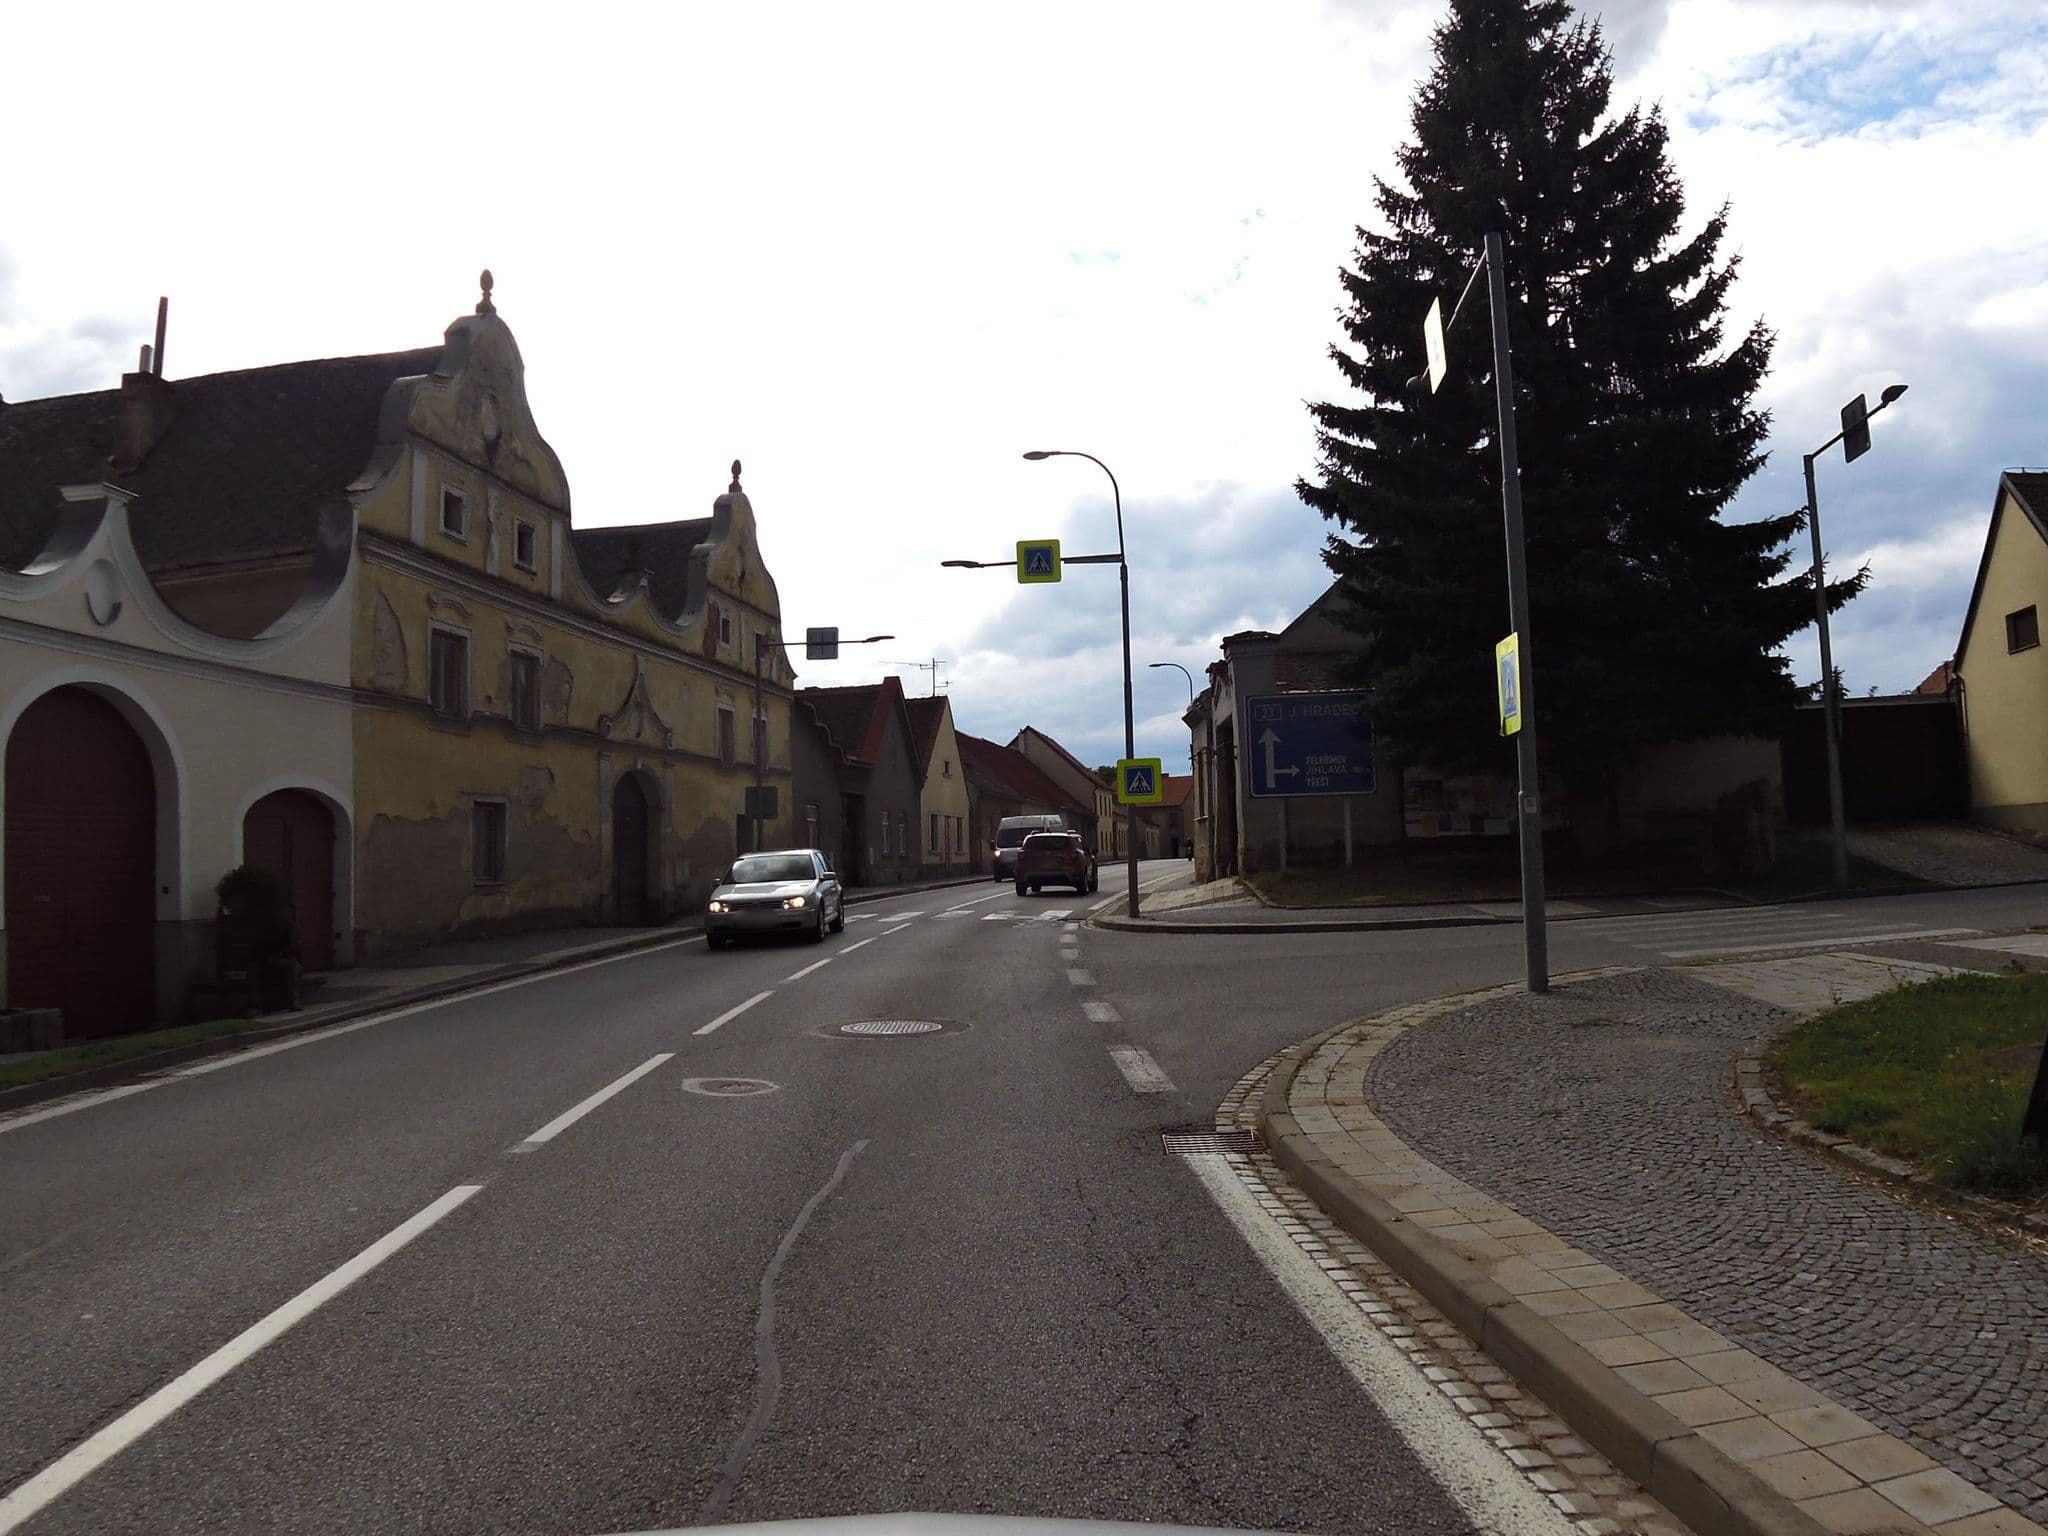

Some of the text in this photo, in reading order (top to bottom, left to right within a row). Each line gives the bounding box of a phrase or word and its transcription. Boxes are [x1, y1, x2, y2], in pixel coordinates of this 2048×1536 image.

[1262, 707, 1274, 718] 23
[1303, 703, 1359, 717] HRADEC
[1305, 764, 1348, 774] JIHLAVA
